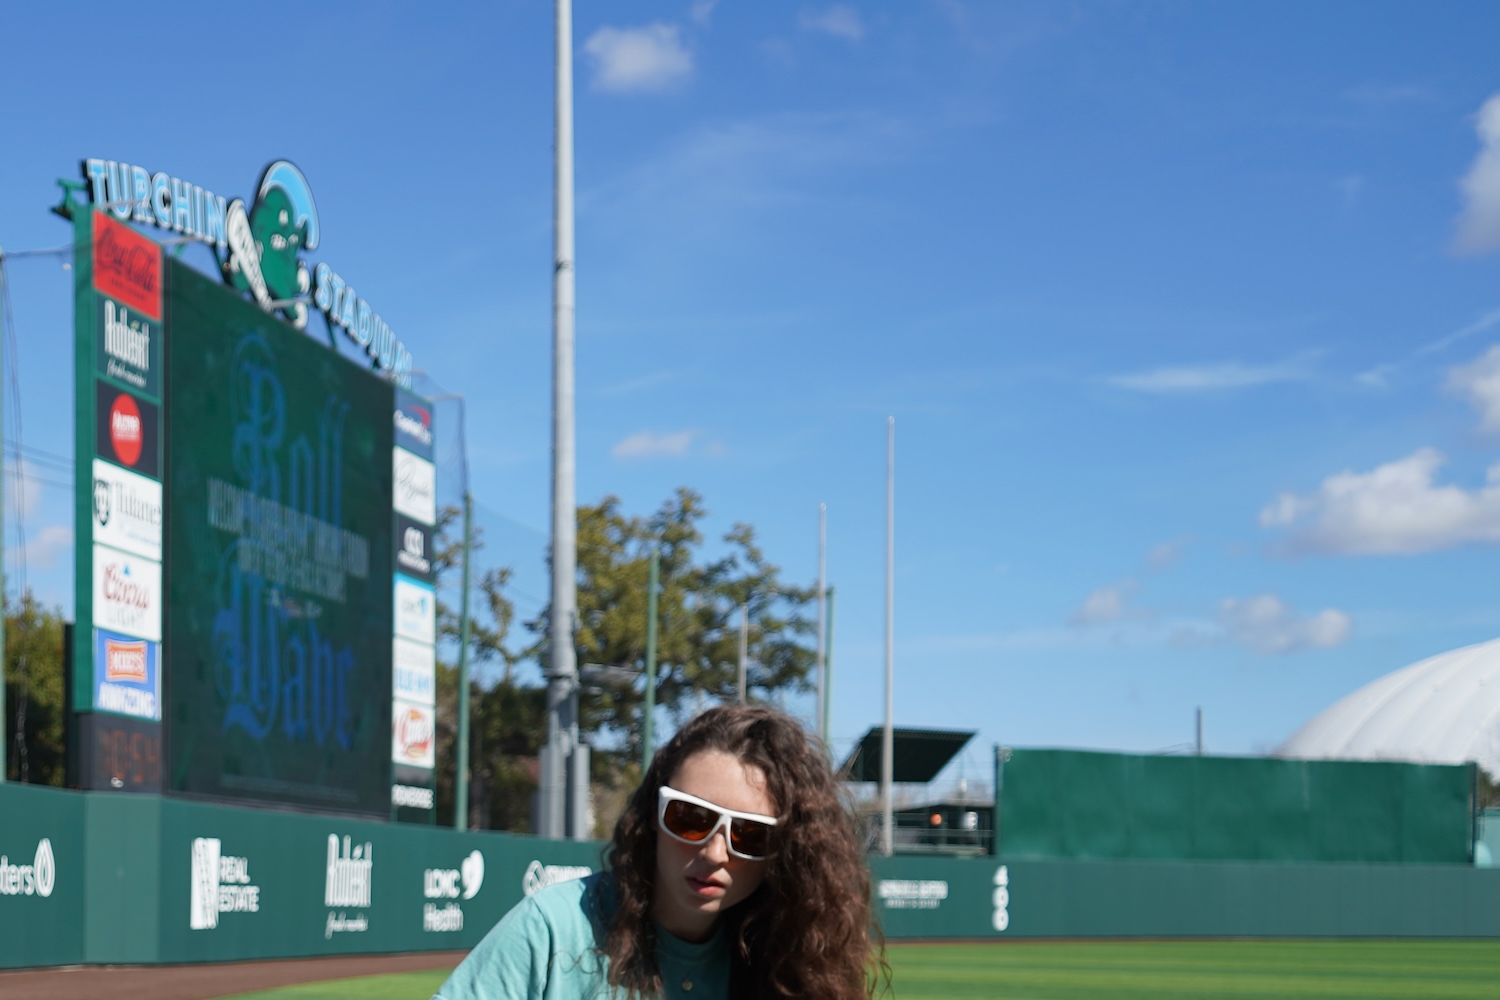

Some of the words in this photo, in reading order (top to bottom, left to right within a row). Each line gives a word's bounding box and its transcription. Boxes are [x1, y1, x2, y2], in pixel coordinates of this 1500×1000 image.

[86, 158, 228, 248] TURCHIN
[315, 262, 412, 390] STADIUM
[219, 855, 251, 884] REAL
[219, 884, 260, 912] ESTATE
[992, 864, 1009, 932] 400
[423, 901, 464, 932] Health
